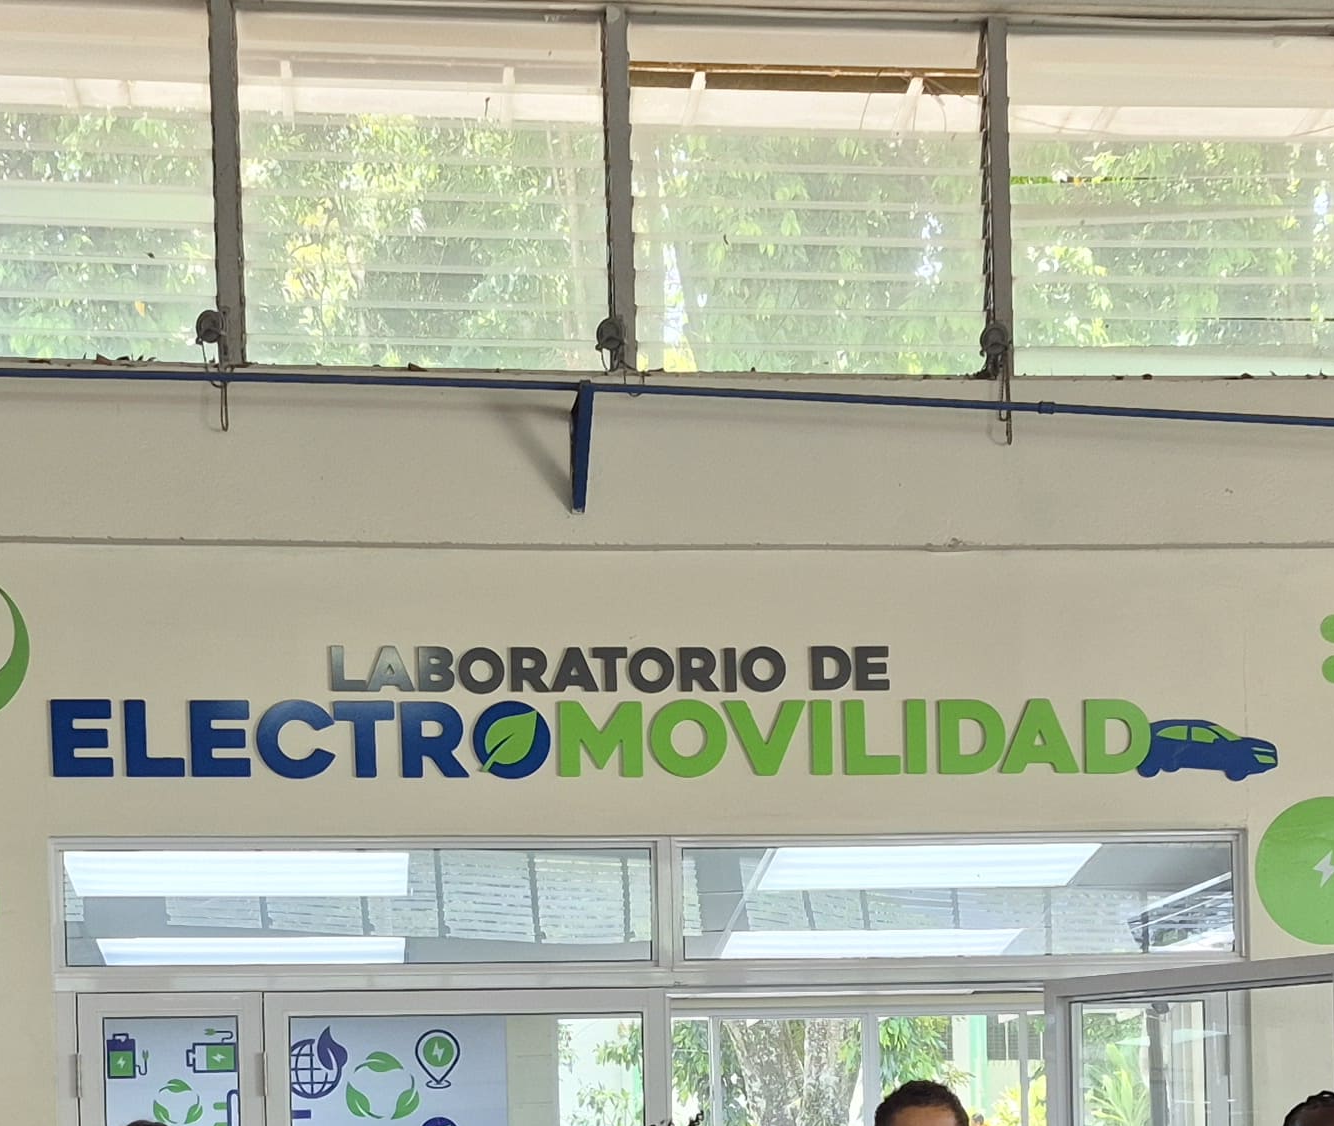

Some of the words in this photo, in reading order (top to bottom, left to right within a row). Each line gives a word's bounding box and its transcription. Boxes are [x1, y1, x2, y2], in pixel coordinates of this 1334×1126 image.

[328, 645, 786, 694] LABORATORIO
[811, 646, 890, 692] DE
[49, 697, 1152, 780] ELECTROMOVILIDAD
